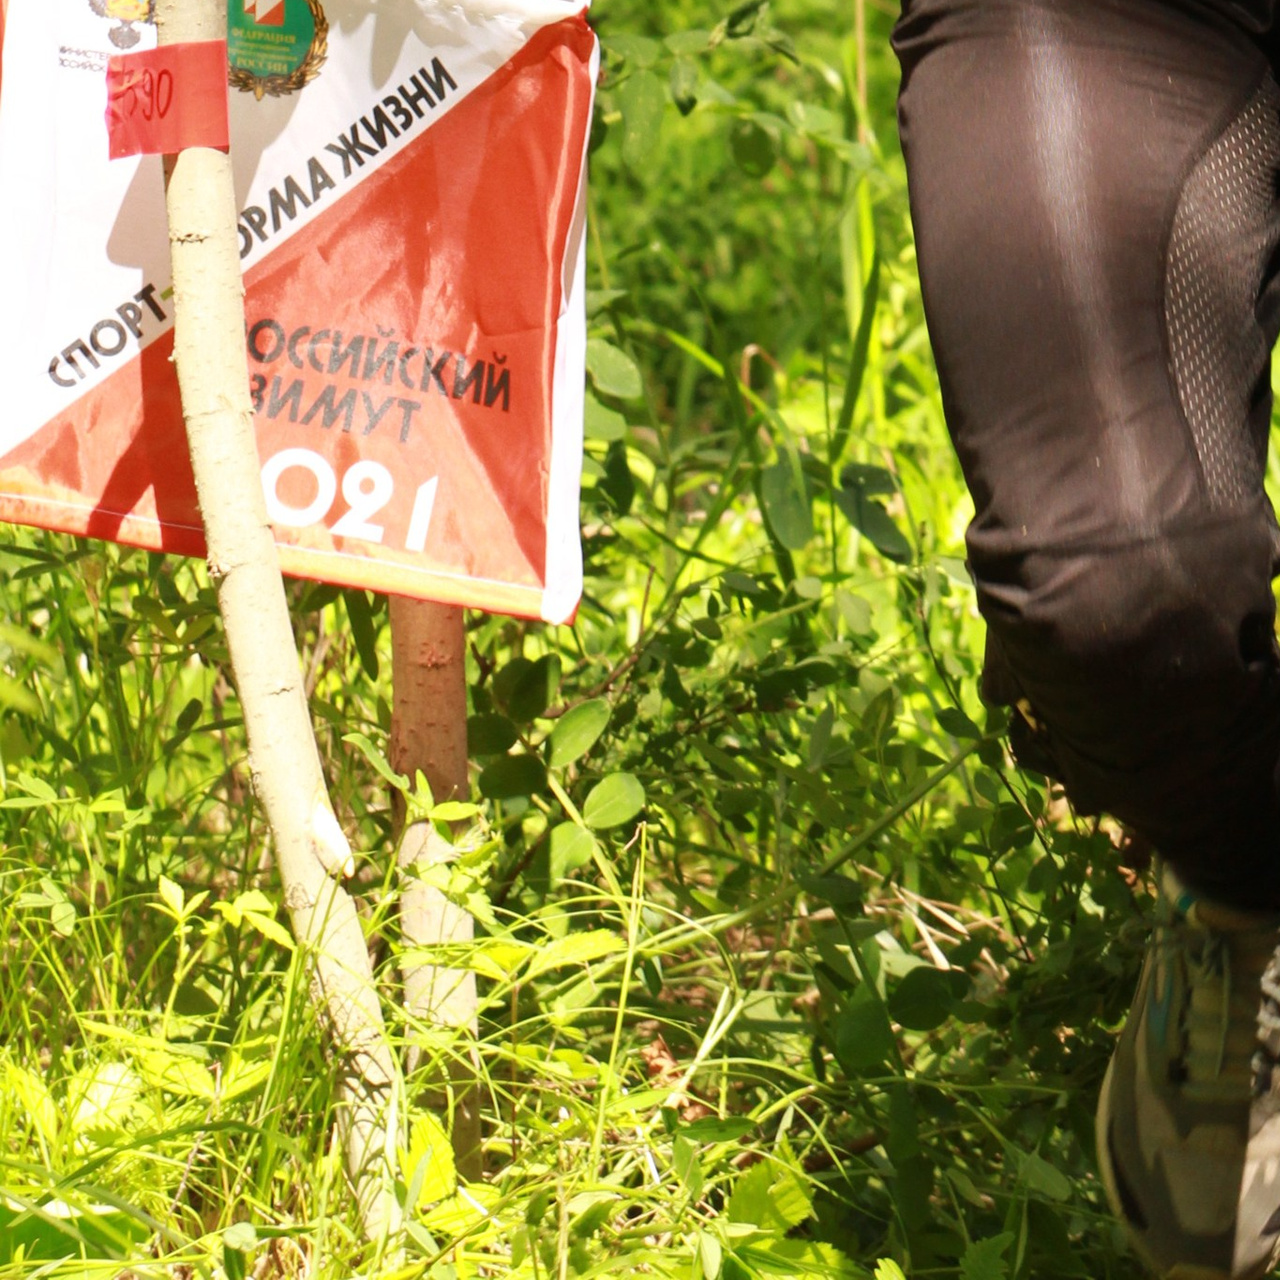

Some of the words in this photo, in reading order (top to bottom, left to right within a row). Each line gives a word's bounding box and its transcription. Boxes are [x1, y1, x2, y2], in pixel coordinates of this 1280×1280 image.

[324, 56, 458, 179] ЖИЗНИ
[244, 318, 510, 413] ОССИЙСКИЙ
[251, 372, 421, 443] ЗИМУТ
[261, 447, 438, 552] 021
